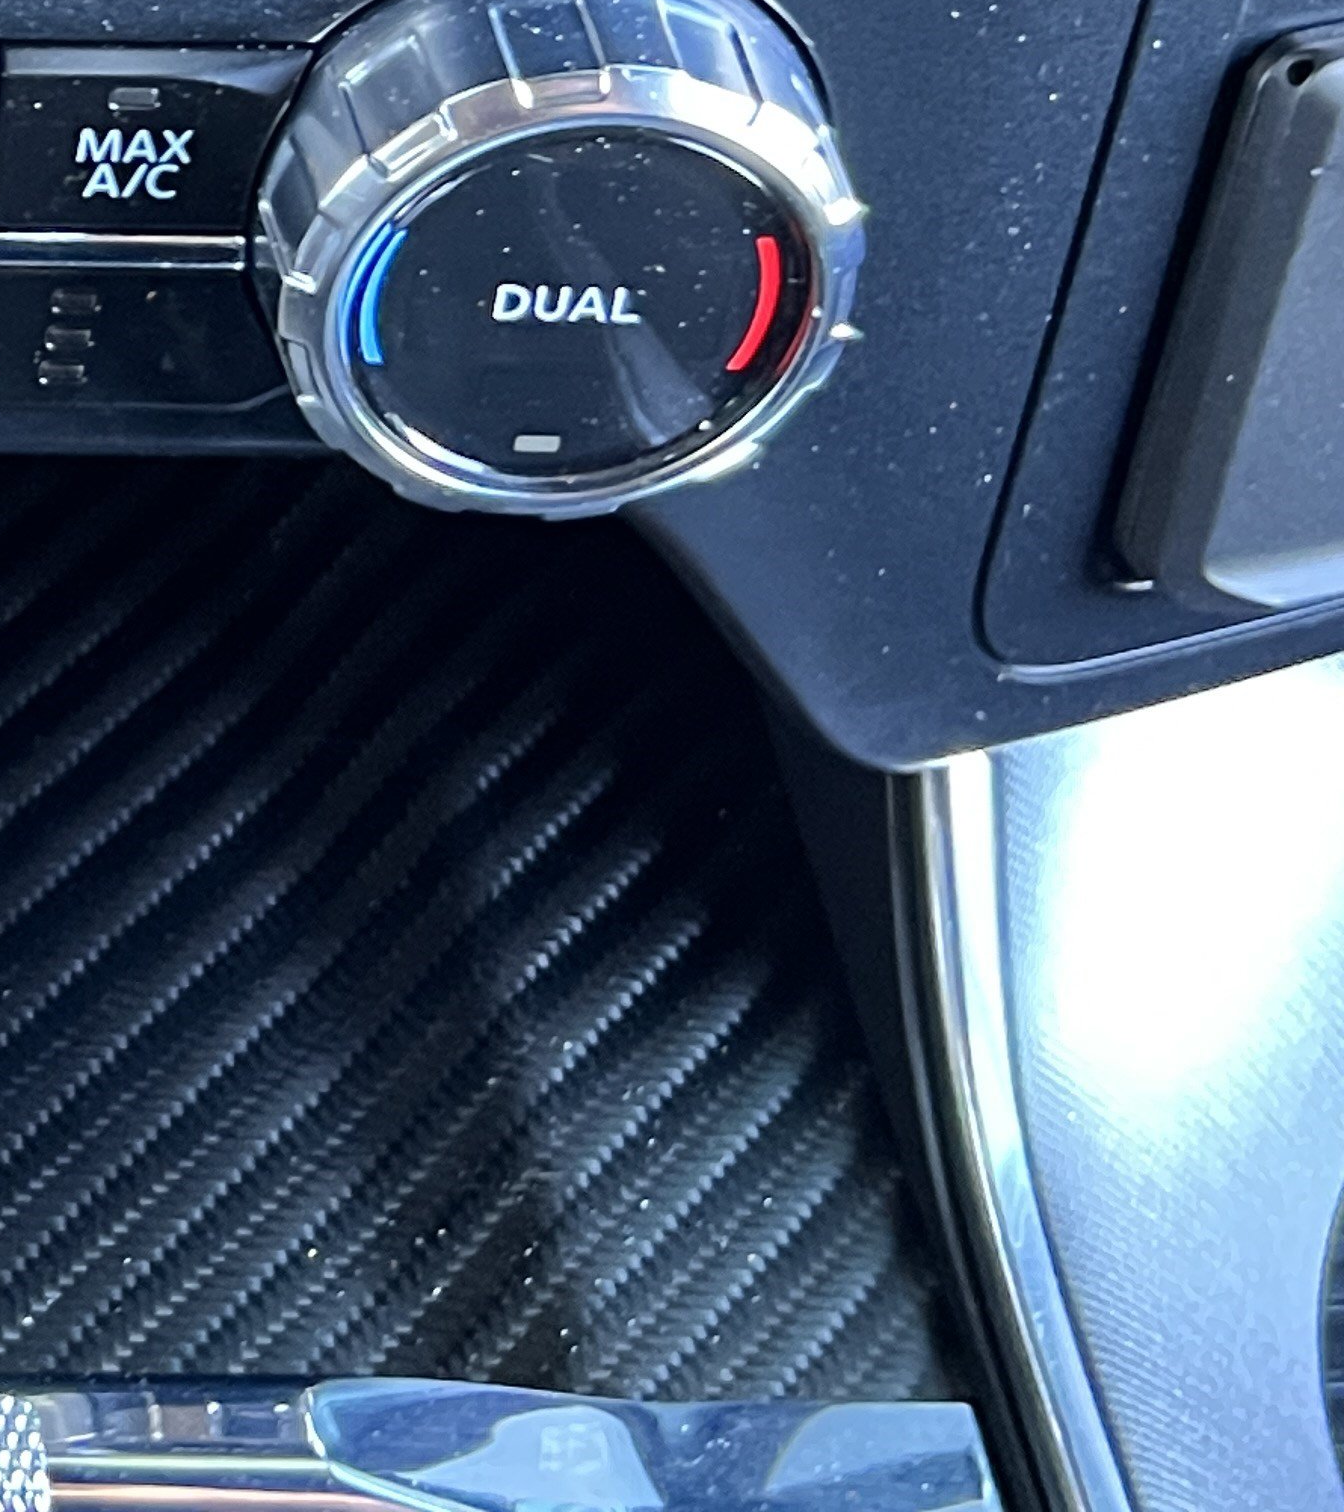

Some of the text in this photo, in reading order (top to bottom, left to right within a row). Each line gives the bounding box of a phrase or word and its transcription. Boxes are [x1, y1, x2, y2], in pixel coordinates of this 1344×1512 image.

[75, 127, 195, 164] MAX
[82, 163, 178, 200] A/C
[491, 283, 643, 326] DUAL
